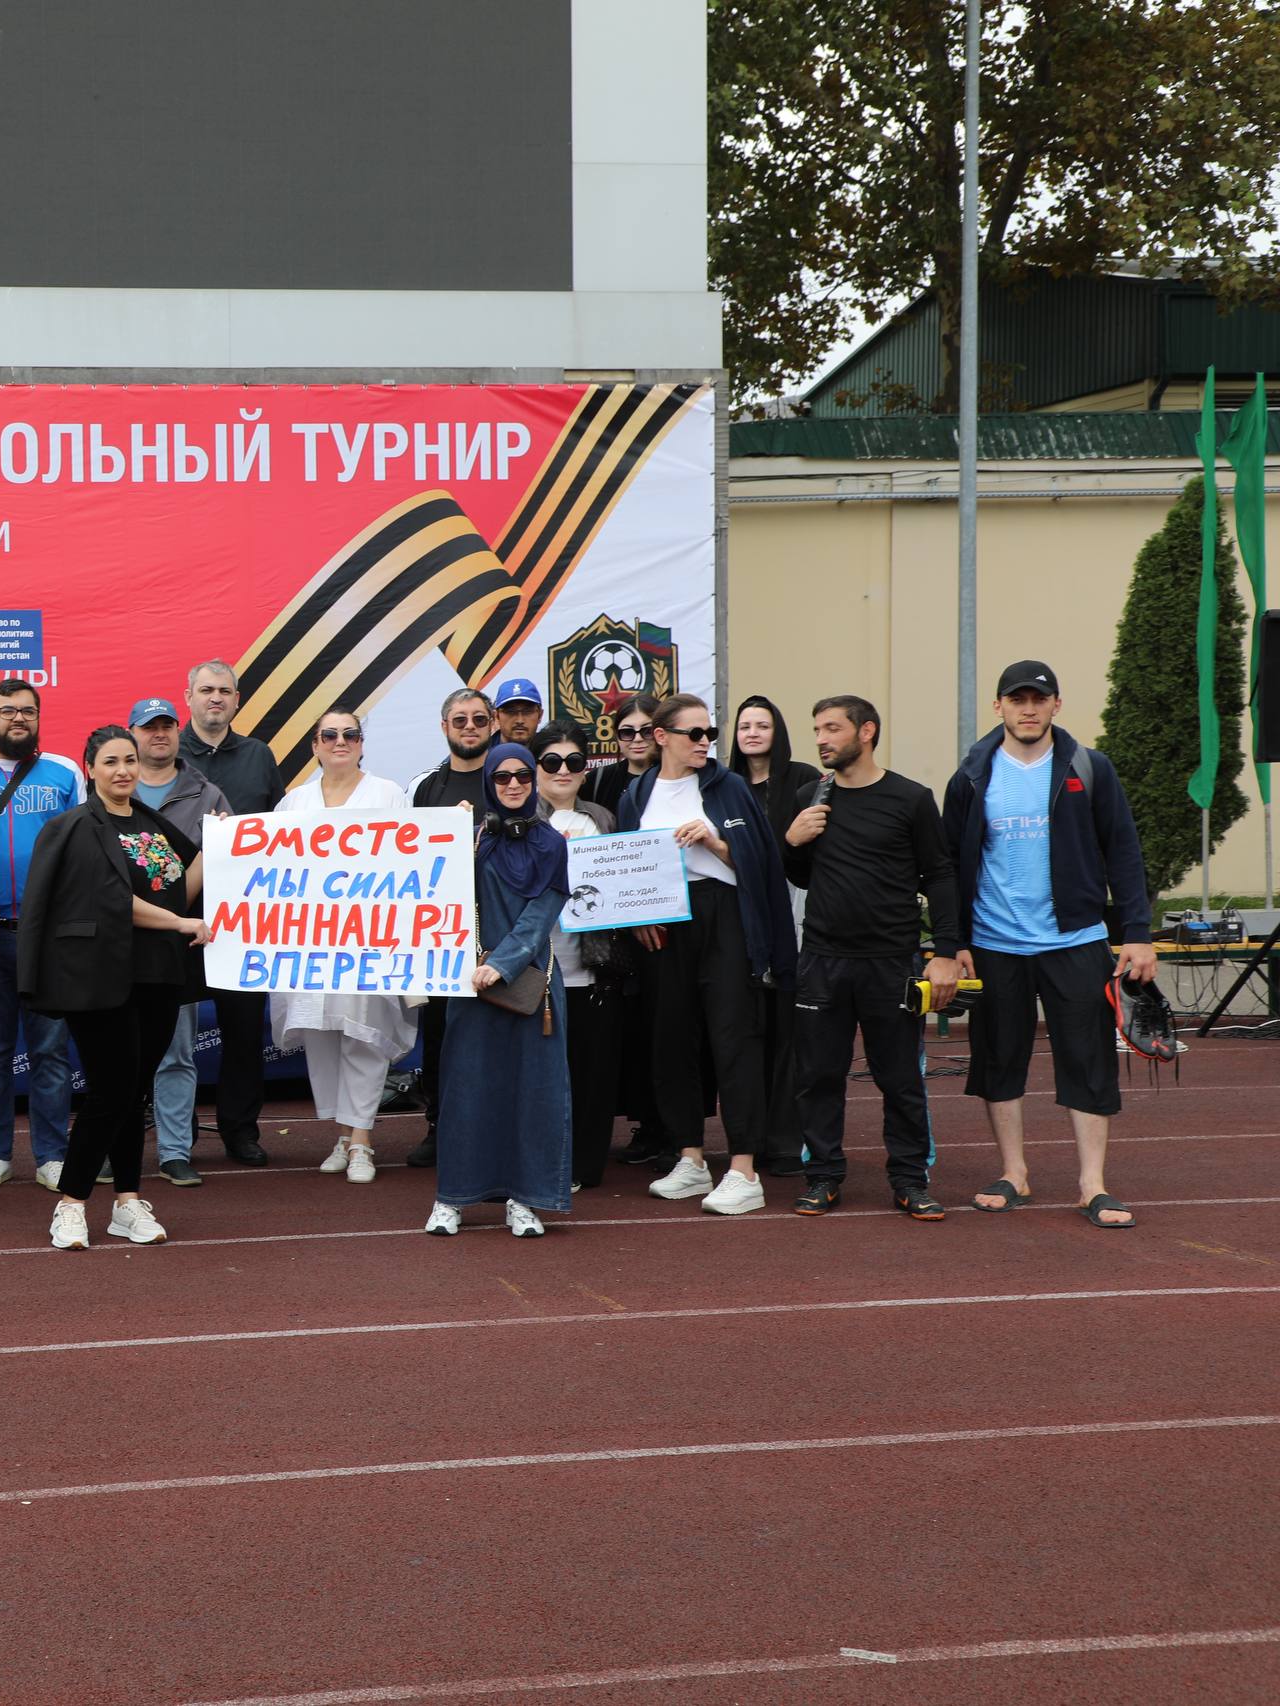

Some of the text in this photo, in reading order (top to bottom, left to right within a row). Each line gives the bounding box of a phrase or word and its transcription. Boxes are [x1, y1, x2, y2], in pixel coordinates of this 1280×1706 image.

[291, 422, 532, 483] ТУРНИР
[10, 619, 20, 627] по
[629, 840, 652, 848] сила
[581, 868, 616, 879] Победа
[630, 863, 658, 873] нами!
[208, 901, 470, 955] МИННАЦ РД
